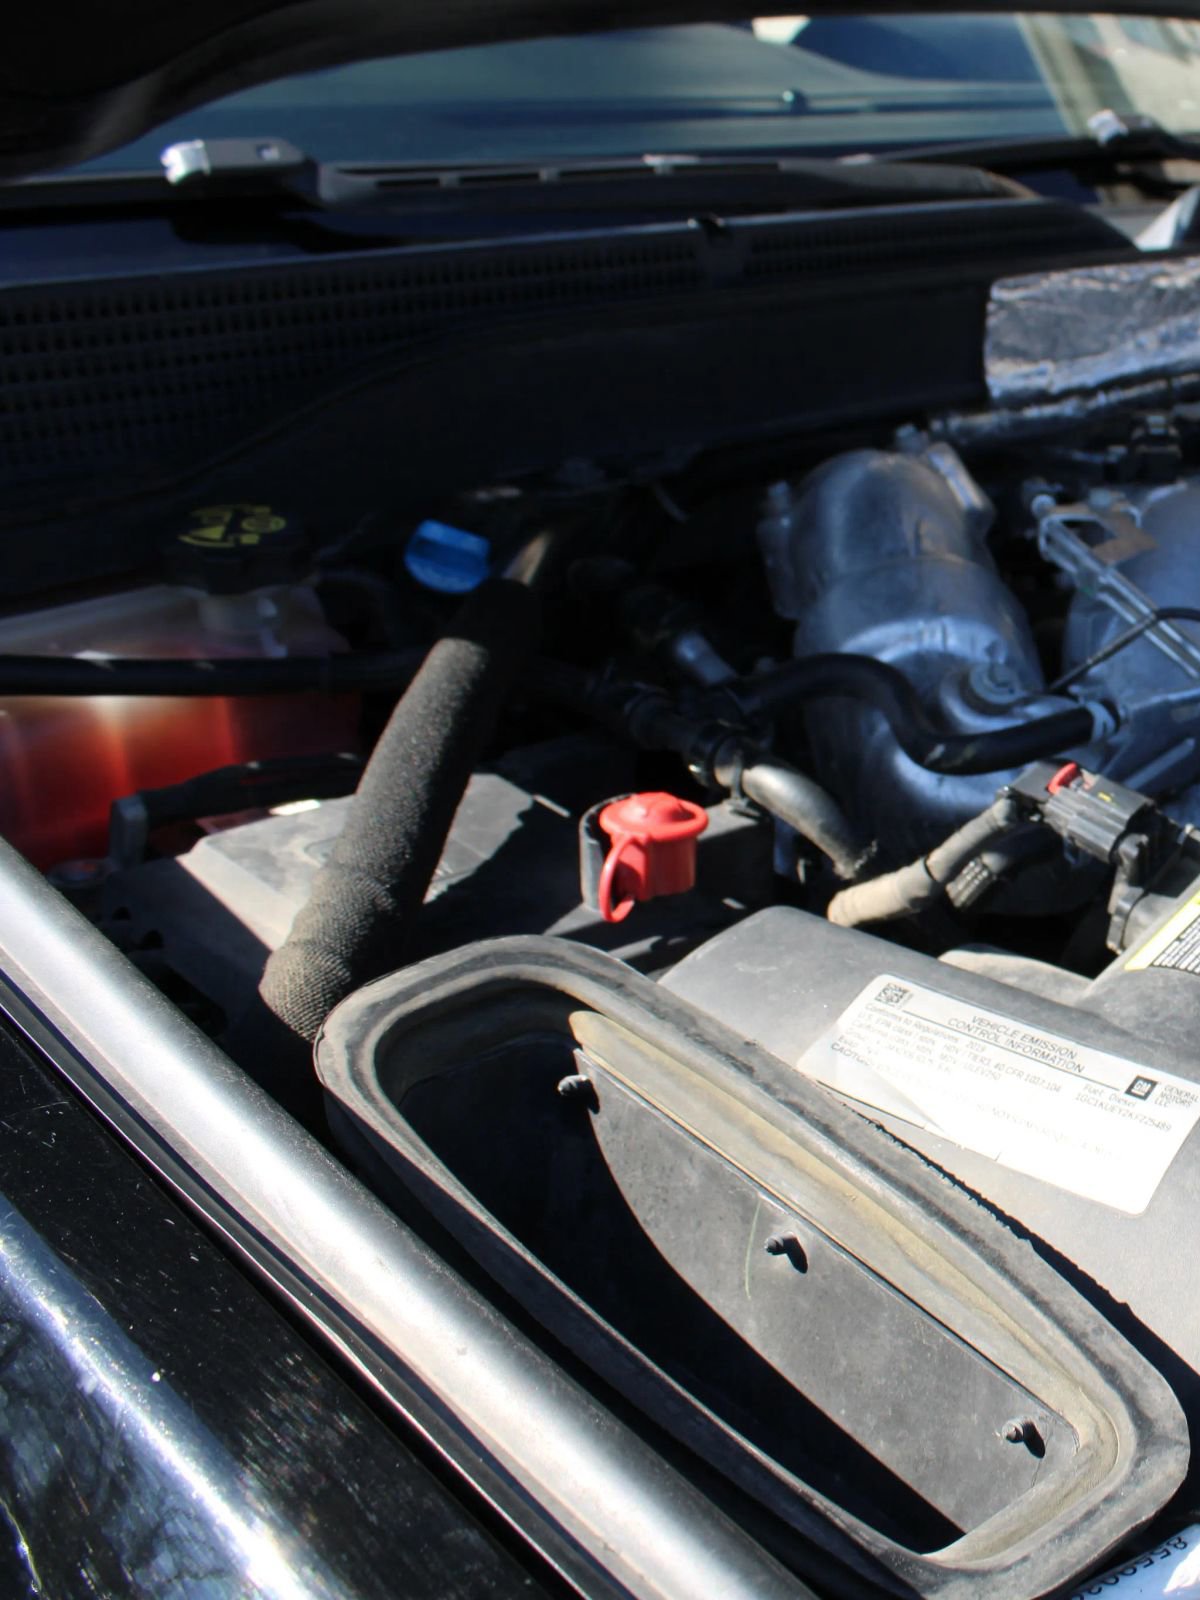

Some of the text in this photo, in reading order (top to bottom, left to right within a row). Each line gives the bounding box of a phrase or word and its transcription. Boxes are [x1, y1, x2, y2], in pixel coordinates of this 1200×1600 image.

[945, 1016, 1085, 1074] CONTROL INFORMATION
[969, 1015, 1078, 1060] VEHICLE EMISSION
[1163, 1083, 1200, 1102] GENERAL
